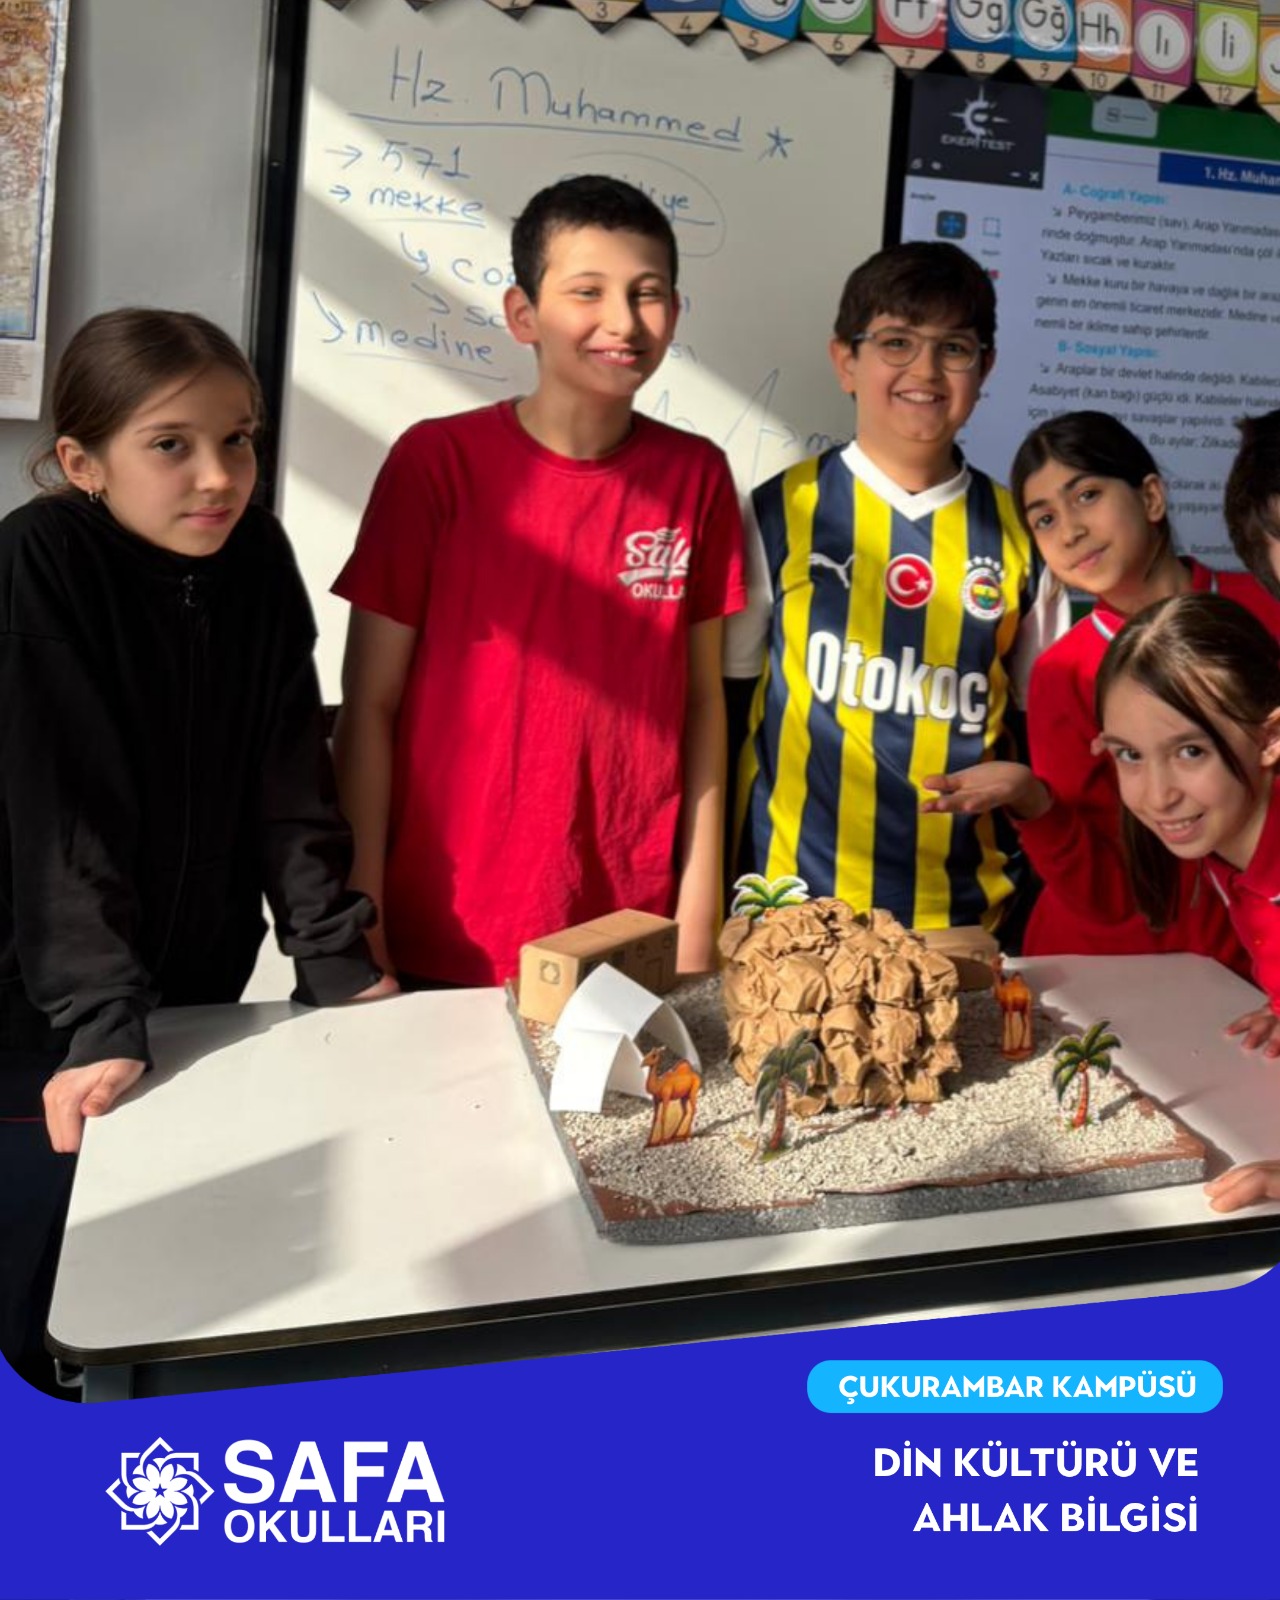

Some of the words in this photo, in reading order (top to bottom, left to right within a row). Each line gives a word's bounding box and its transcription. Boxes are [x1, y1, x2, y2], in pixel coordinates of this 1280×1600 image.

[595, 2, 609, 19] 3
[679, 15, 692, 34] 4
[1080, 11, 1120, 45] Hh
[747, 29, 759, 48] 5
[831, 34, 845, 51] 6
[904, 49, 916, 65] 7
[975, 52, 986, 69] 8
[1038, 61, 1049, 78] 9
[1090, 72, 1107, 89] 10
[1151, 82, 1166, 99] 11
[1216, 86, 1232, 102] 12
[489, 67, 743, 143] Muhammed
[382, 141, 470, 181] 571
[1204, 166, 1215, 180] 1.
[1218, 167, 1237, 182] Hz.
[1068, 205, 1156, 226] Peygamberimiz
[1192, 219, 1219, 233] Arap
[1041, 228, 1071, 241] rinde
[1140, 235, 1167, 250] Arap
[1083, 254, 1112, 266] sıcak
[1116, 258, 1130, 268] ve
[1062, 273, 1101, 287] Mekke
[1104, 278, 1129, 290] kuru
[1131, 279, 1146, 291] bir
[1148, 282, 1189, 297] havaya
[1192, 286, 1206, 297] ve
[1243, 288, 1257, 300] bir
[1071, 299, 1086, 309] en
[1088, 298, 1126, 311] önemli
[1129, 301, 1164, 314] ticaret
[1228, 309, 1267, 322] Medine
[1034, 318, 1066, 330] nemli
[1068, 320, 1083, 331] bir
[1086, 321, 1119, 333] iklime
[1122, 324, 1153, 338] sahip
[1074, 340, 1116, 357] Sosyal
[1055, 362, 1098, 377] Araplar
[1100, 364, 1116, 376] bir
[1118, 365, 1153, 379] devlet
[1155, 369, 1196, 383] halinde
[1028, 383, 1081, 399] Asabiyet
[1082, 386, 1108, 400] (kan
[1149, 433, 1166, 446] Bu
[807, 630, 988, 734] Otokoç
